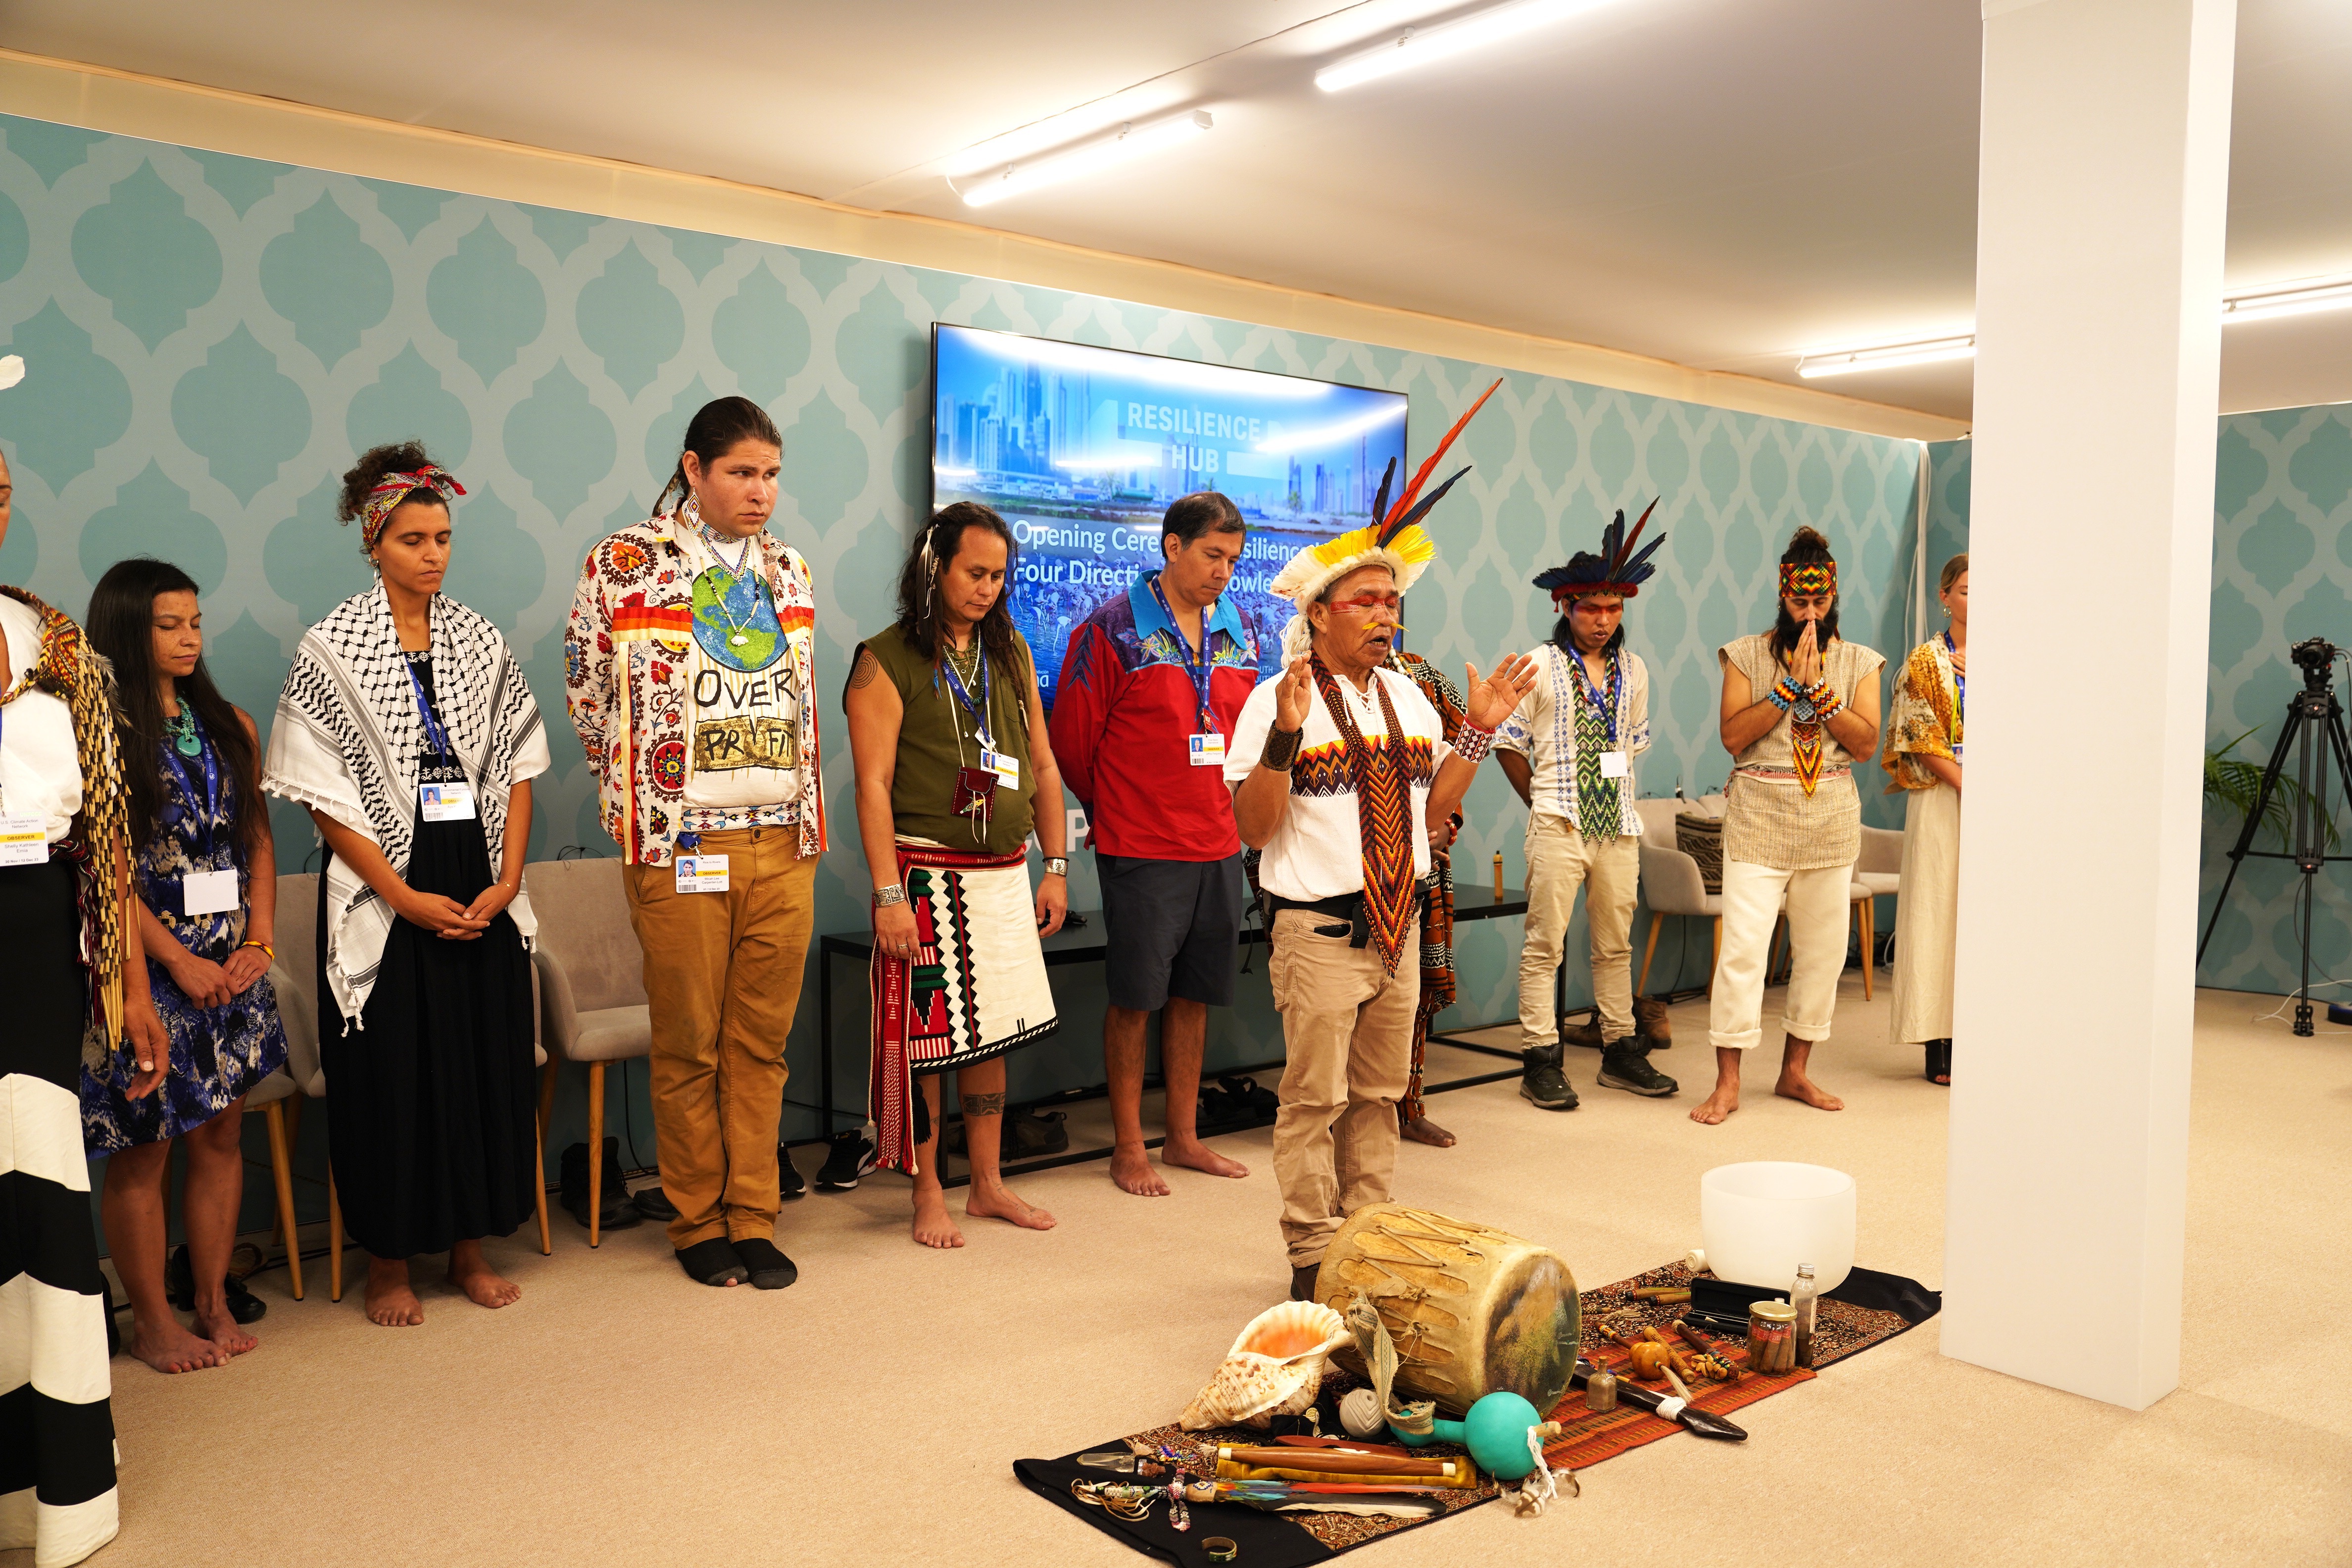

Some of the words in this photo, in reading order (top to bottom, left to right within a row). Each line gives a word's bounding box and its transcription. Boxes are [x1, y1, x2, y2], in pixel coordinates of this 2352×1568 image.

[1127, 402, 1261, 442] RESILIENCE
[1172, 444, 1219, 473] HUB
[1013, 519, 1106, 554] Opening
[1112, 527, 1161, 553] Cere
[1014, 557, 1063, 583] Four
[694, 668, 796, 709] OVER
